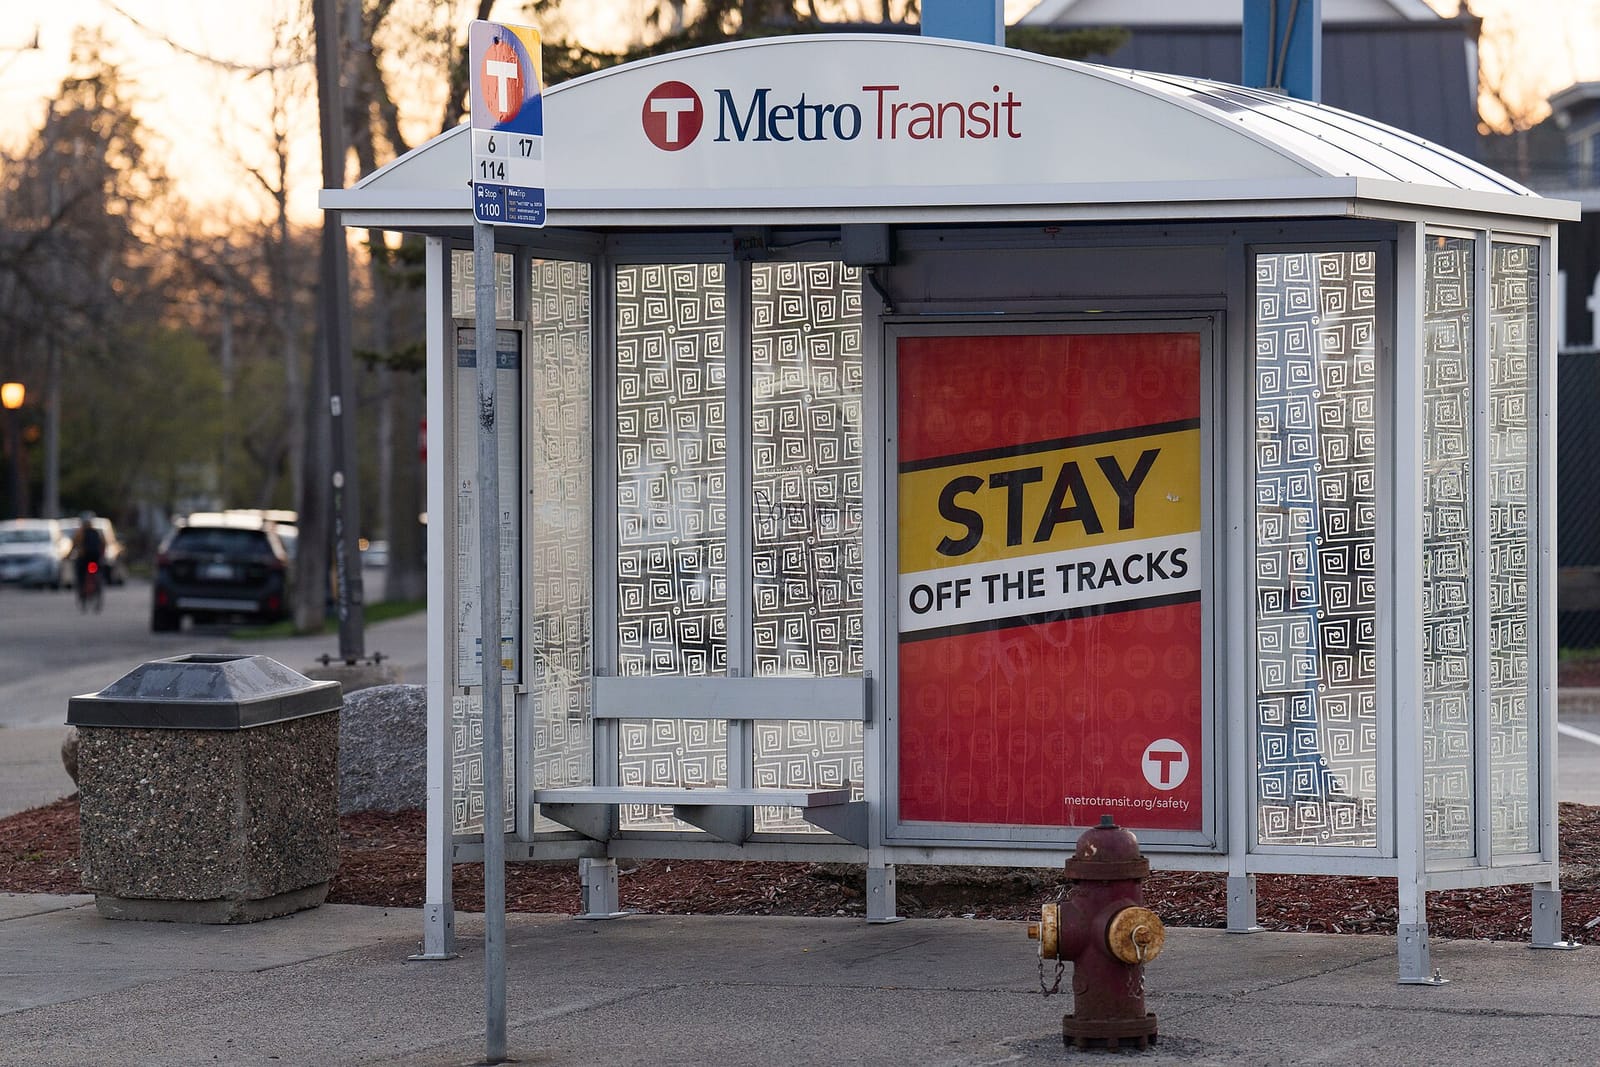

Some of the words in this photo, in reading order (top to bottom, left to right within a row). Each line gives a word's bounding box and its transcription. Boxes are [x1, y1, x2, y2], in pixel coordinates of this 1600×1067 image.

[486, 60, 518, 113] T
[713, 88, 862, 142] Metro
[862, 84, 1022, 140] Transit
[488, 136, 496, 154] 6
[518, 138, 533, 157] 17
[480, 160, 505, 180] 114
[485, 188, 497, 200] Stop
[479, 203, 500, 217] 1100
[935, 448, 1162, 557] STAY
[503, 511, 510, 521] 17
[909, 578, 972, 615] OFF
[982, 567, 1046, 605] THE
[1056, 548, 1189, 594] TRACKS
[1064, 795, 1190, 812] metrotransit.org/safety
